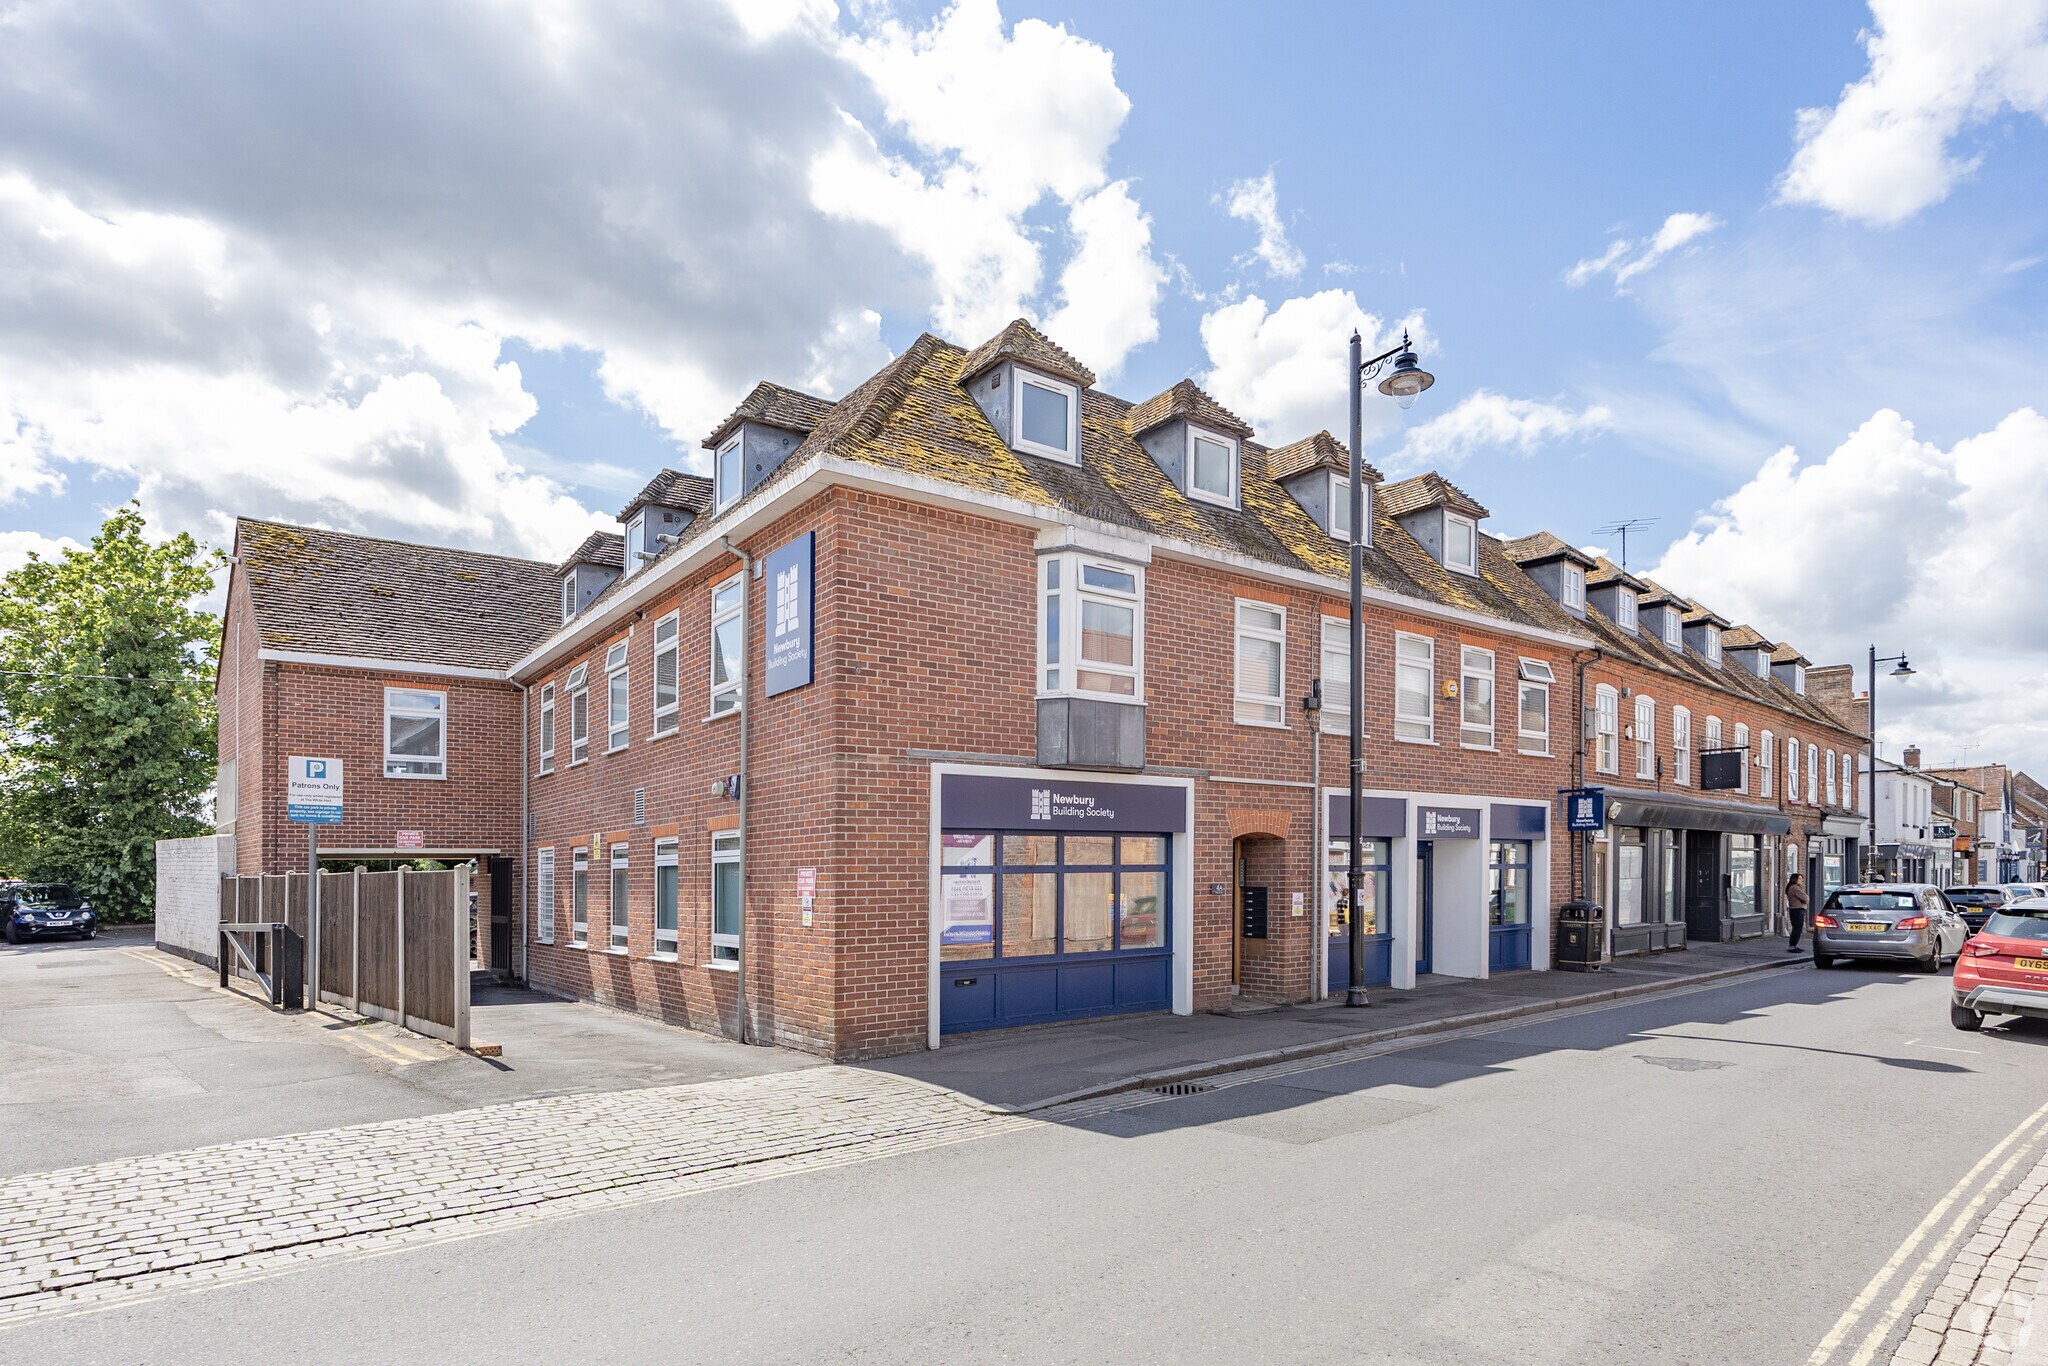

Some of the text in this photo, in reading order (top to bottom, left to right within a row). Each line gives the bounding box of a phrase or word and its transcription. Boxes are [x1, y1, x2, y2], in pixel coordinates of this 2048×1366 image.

[773, 637, 800, 654] Newbury
[768, 648, 807, 670] Building Society
[1053, 794, 1094, 807] Newbury
[1053, 806, 1115, 819] Building Society
[1437, 814, 1460, 824] Newbury
[1437, 824, 1471, 833] Building Society
